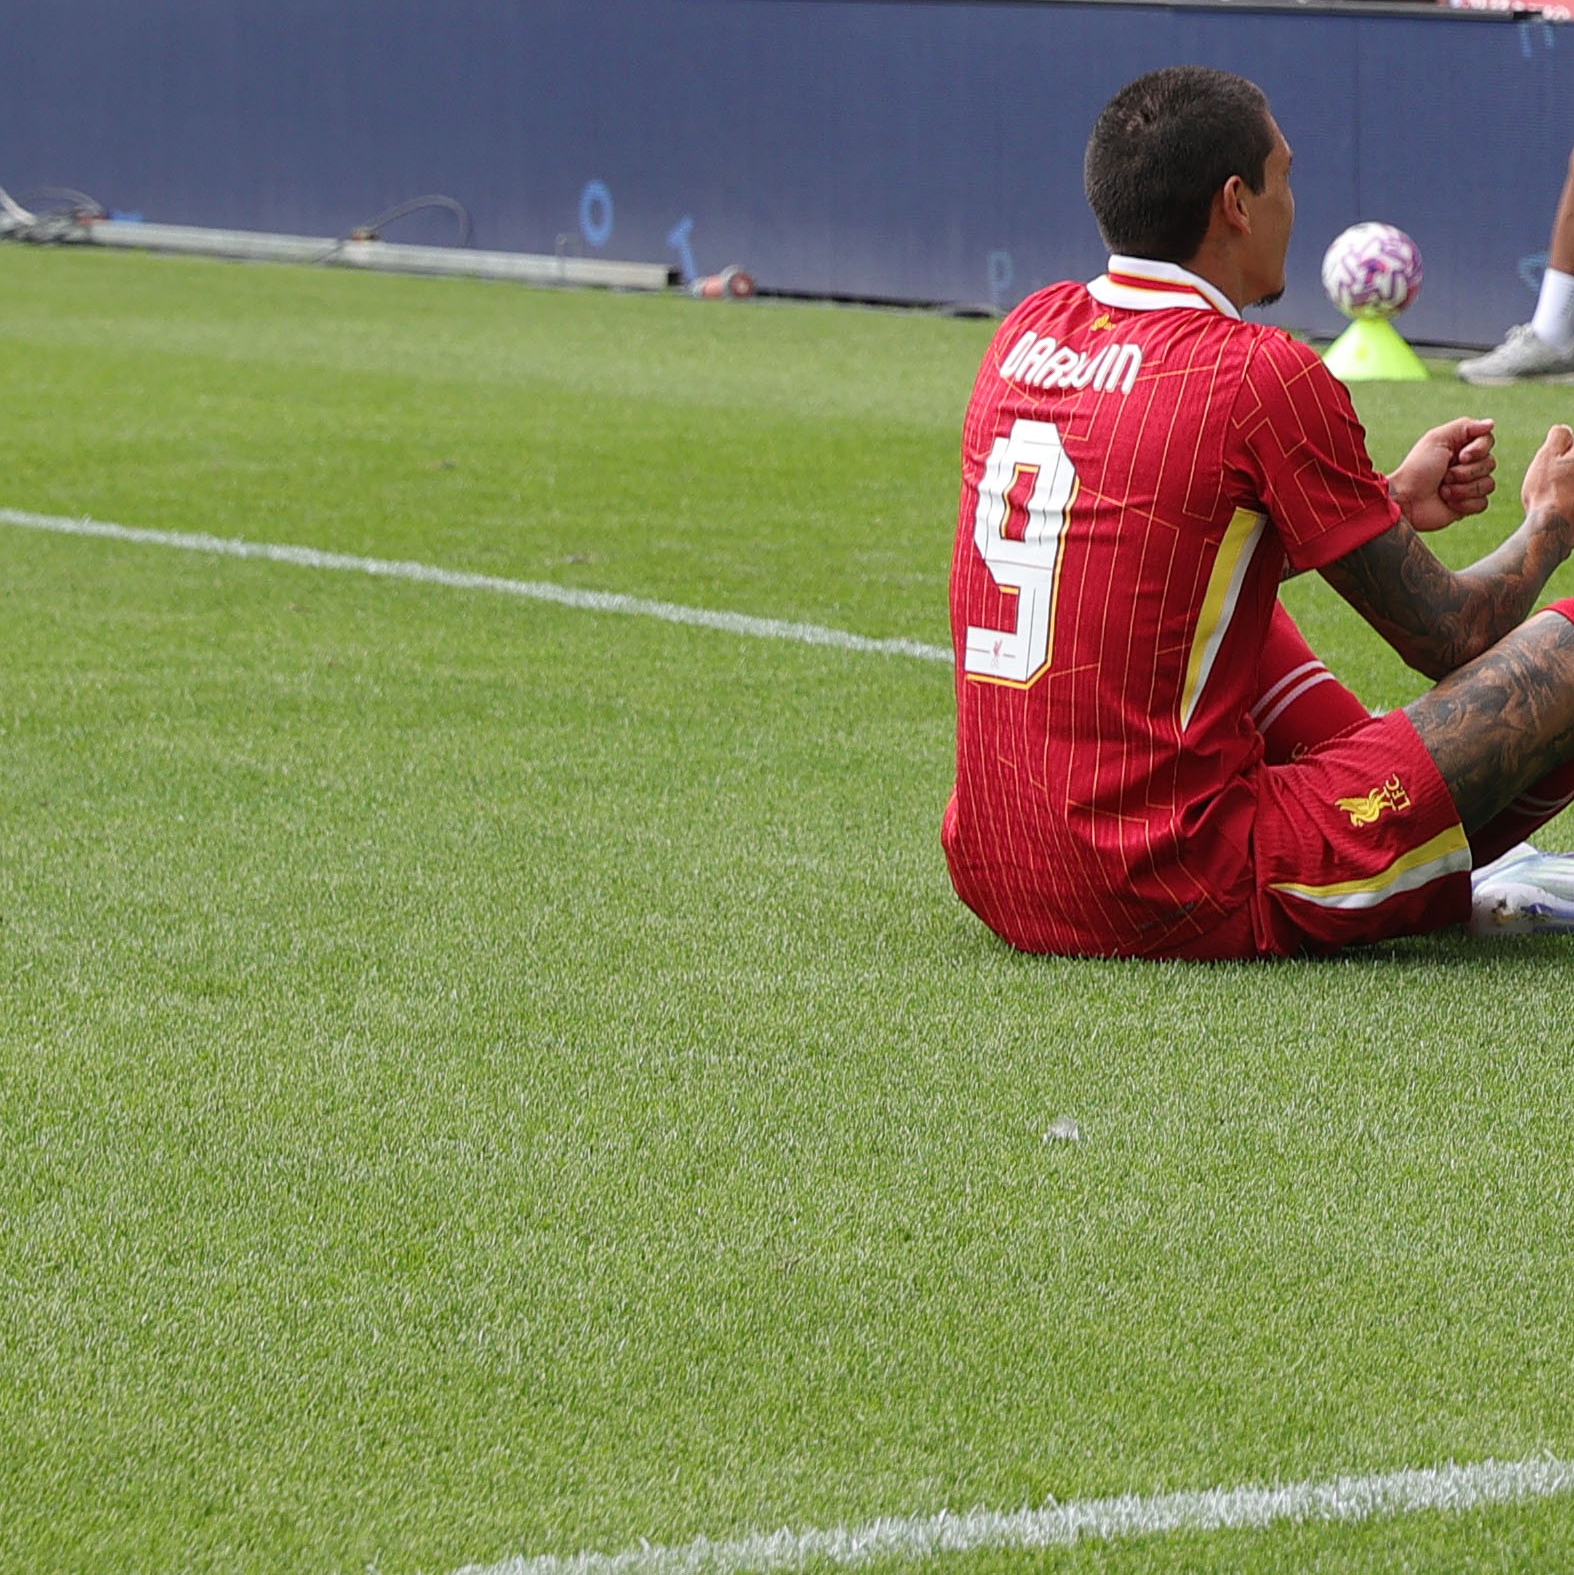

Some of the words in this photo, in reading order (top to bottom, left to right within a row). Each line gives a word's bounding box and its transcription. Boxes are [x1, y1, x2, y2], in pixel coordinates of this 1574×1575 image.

[999, 330, 1143, 396] DARWIN
[965, 419, 1081, 689] 9
[1385, 772, 1412, 812] LFC
